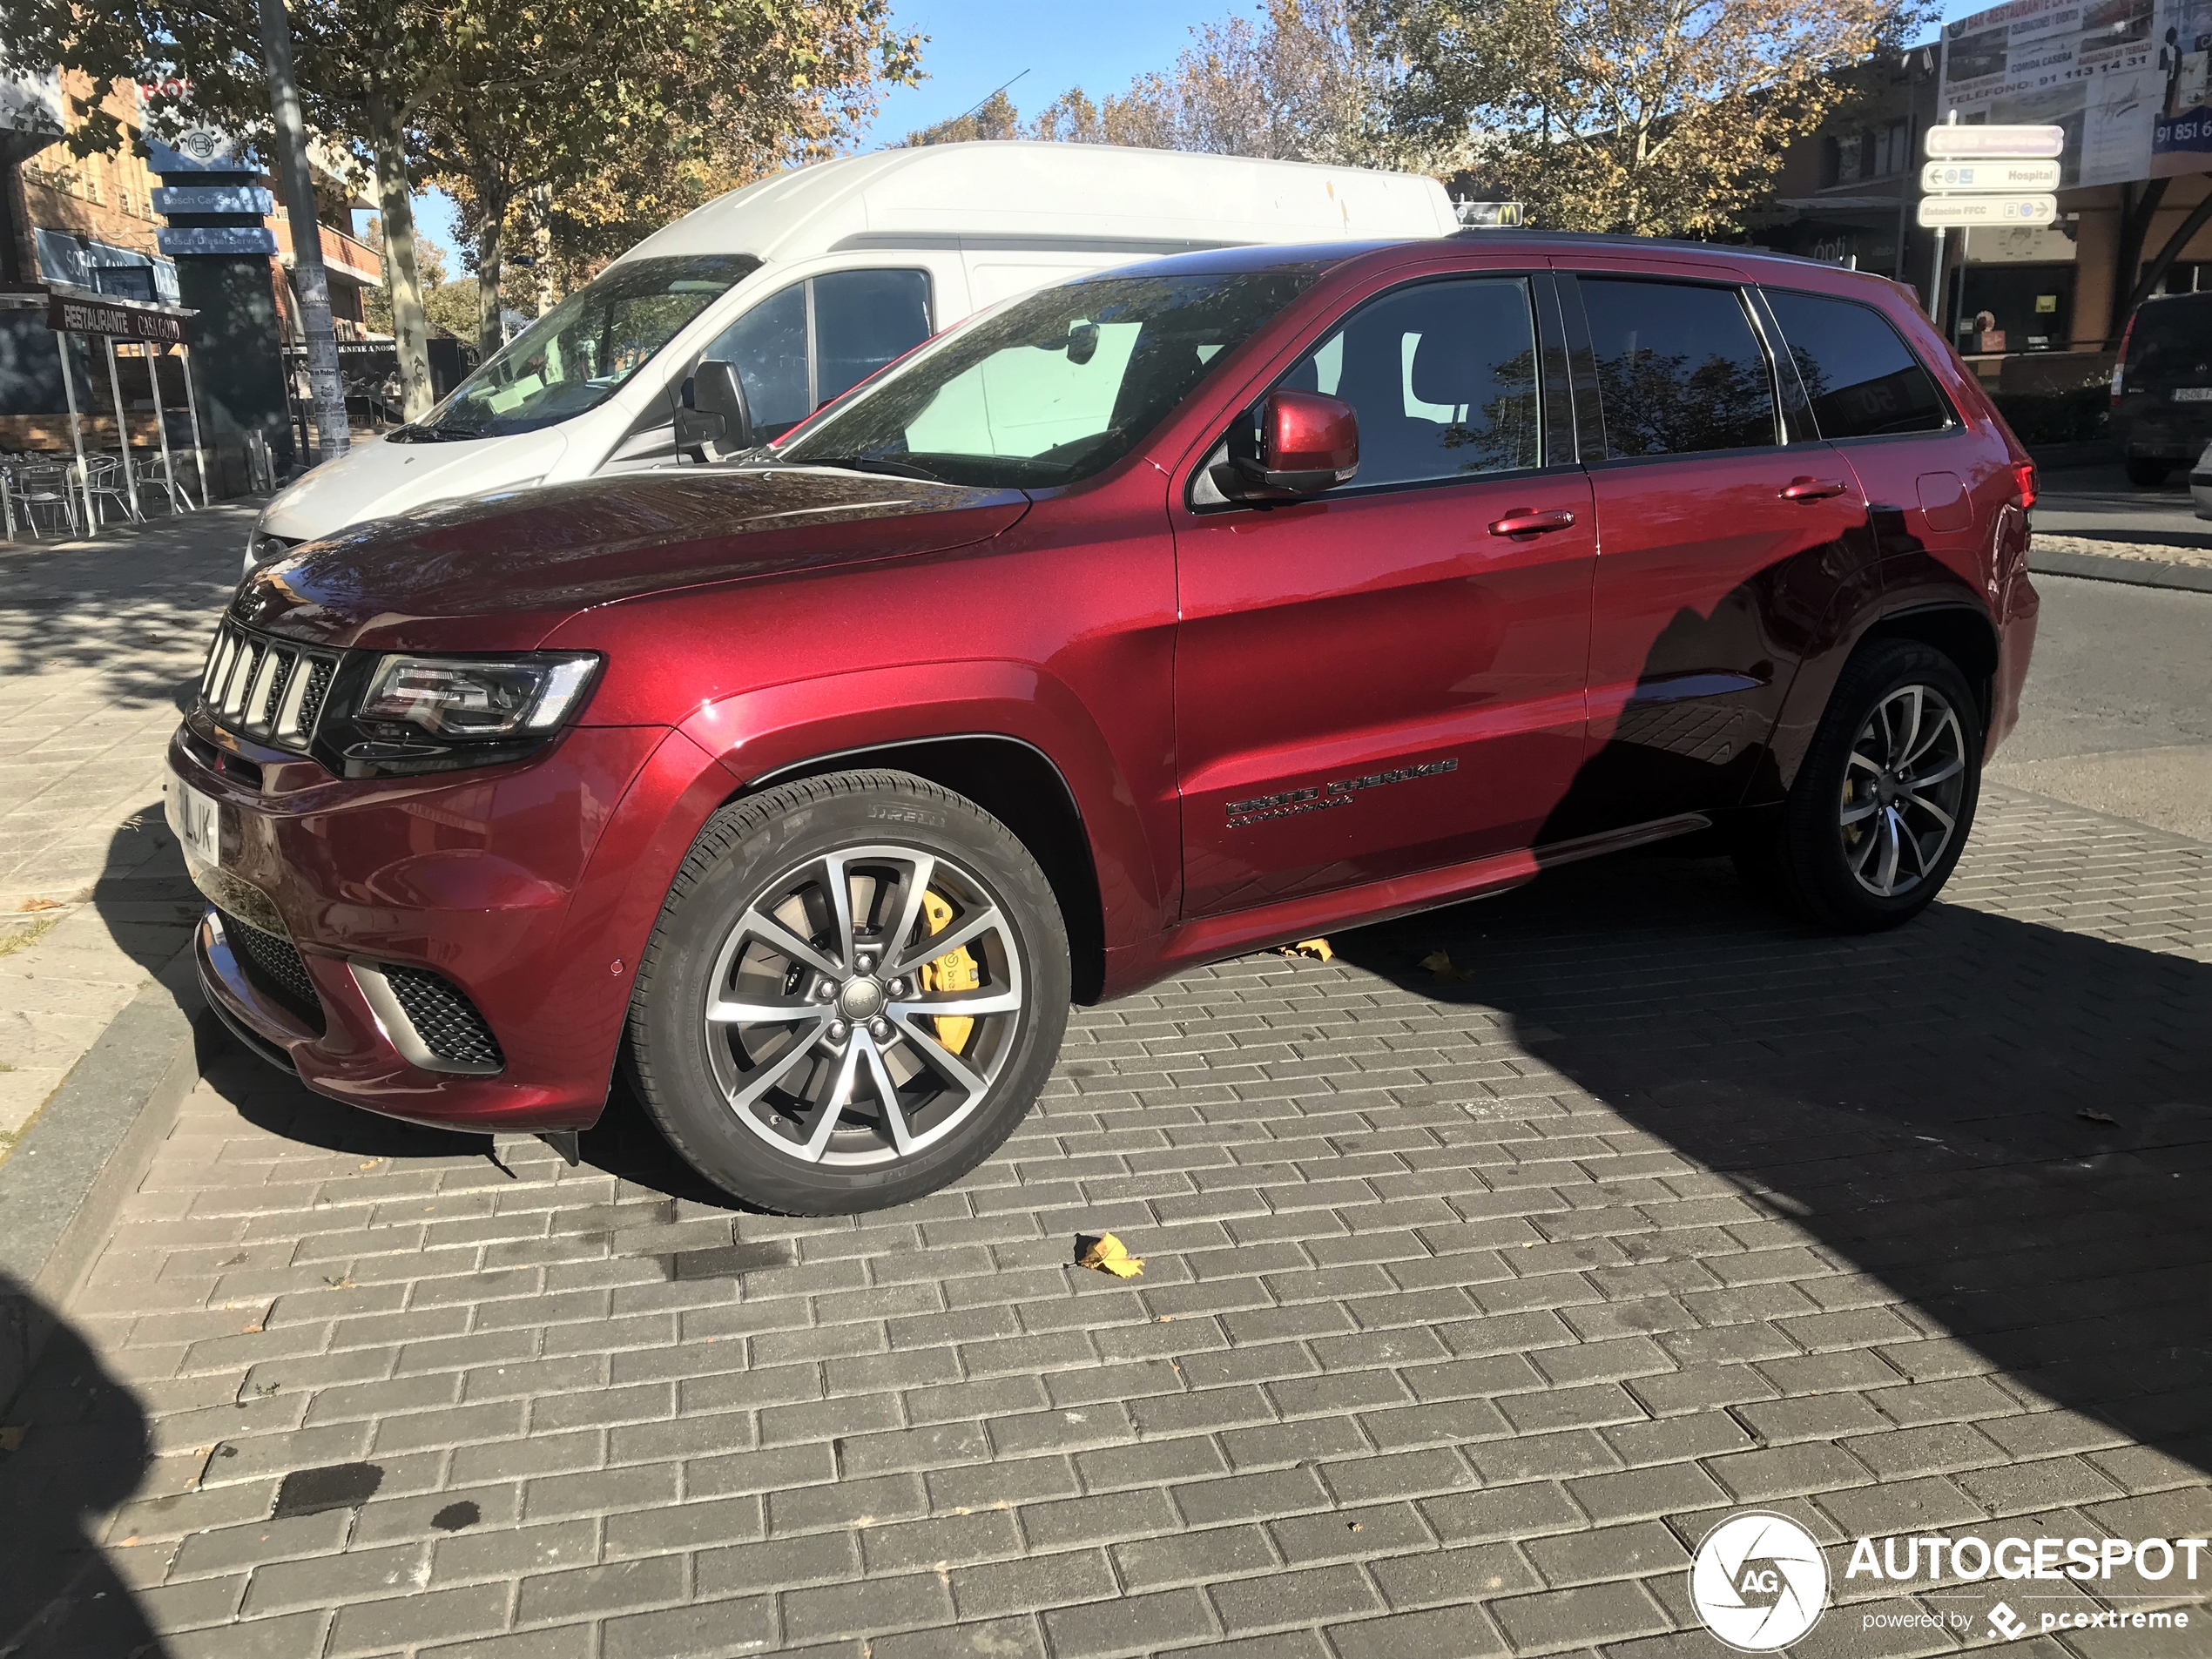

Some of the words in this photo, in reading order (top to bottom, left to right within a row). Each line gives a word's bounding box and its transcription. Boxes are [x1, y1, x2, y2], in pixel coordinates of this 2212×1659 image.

[2012, 60, 2040, 73] COMIDA
[2042, 51, 2072, 66] CASERA
[2040, 74, 2056, 85] 91
[2065, 67, 2094, 79] 113
[2100, 60, 2121, 72] 14
[2127, 55, 2147, 66] 31
[2156, 126, 2171, 143] 91
[2175, 122, 2197, 139] 851
[2008, 170, 2053, 182] Hospital
[163, 194, 194, 205] Bosch
[198, 195, 216, 206] Car
[218, 194, 254, 206] Service
[1924, 206, 1961, 216] Estación
[1964, 206, 1986, 215] FFCC
[164, 236, 194, 245] Bosch
[198, 236, 227, 245] Diesel
[229, 236, 265, 245] Service
[64, 304, 129, 334] RESTAURANTE
[138, 315, 158, 336] CASA
[158, 318, 180, 340] GOYO
[1225, 786, 1318, 816] GRAND
[1326, 758, 1459, 796] CHEROKEE
[185, 794, 211, 853] LJK
[848, 994, 877, 1008] Jeep
